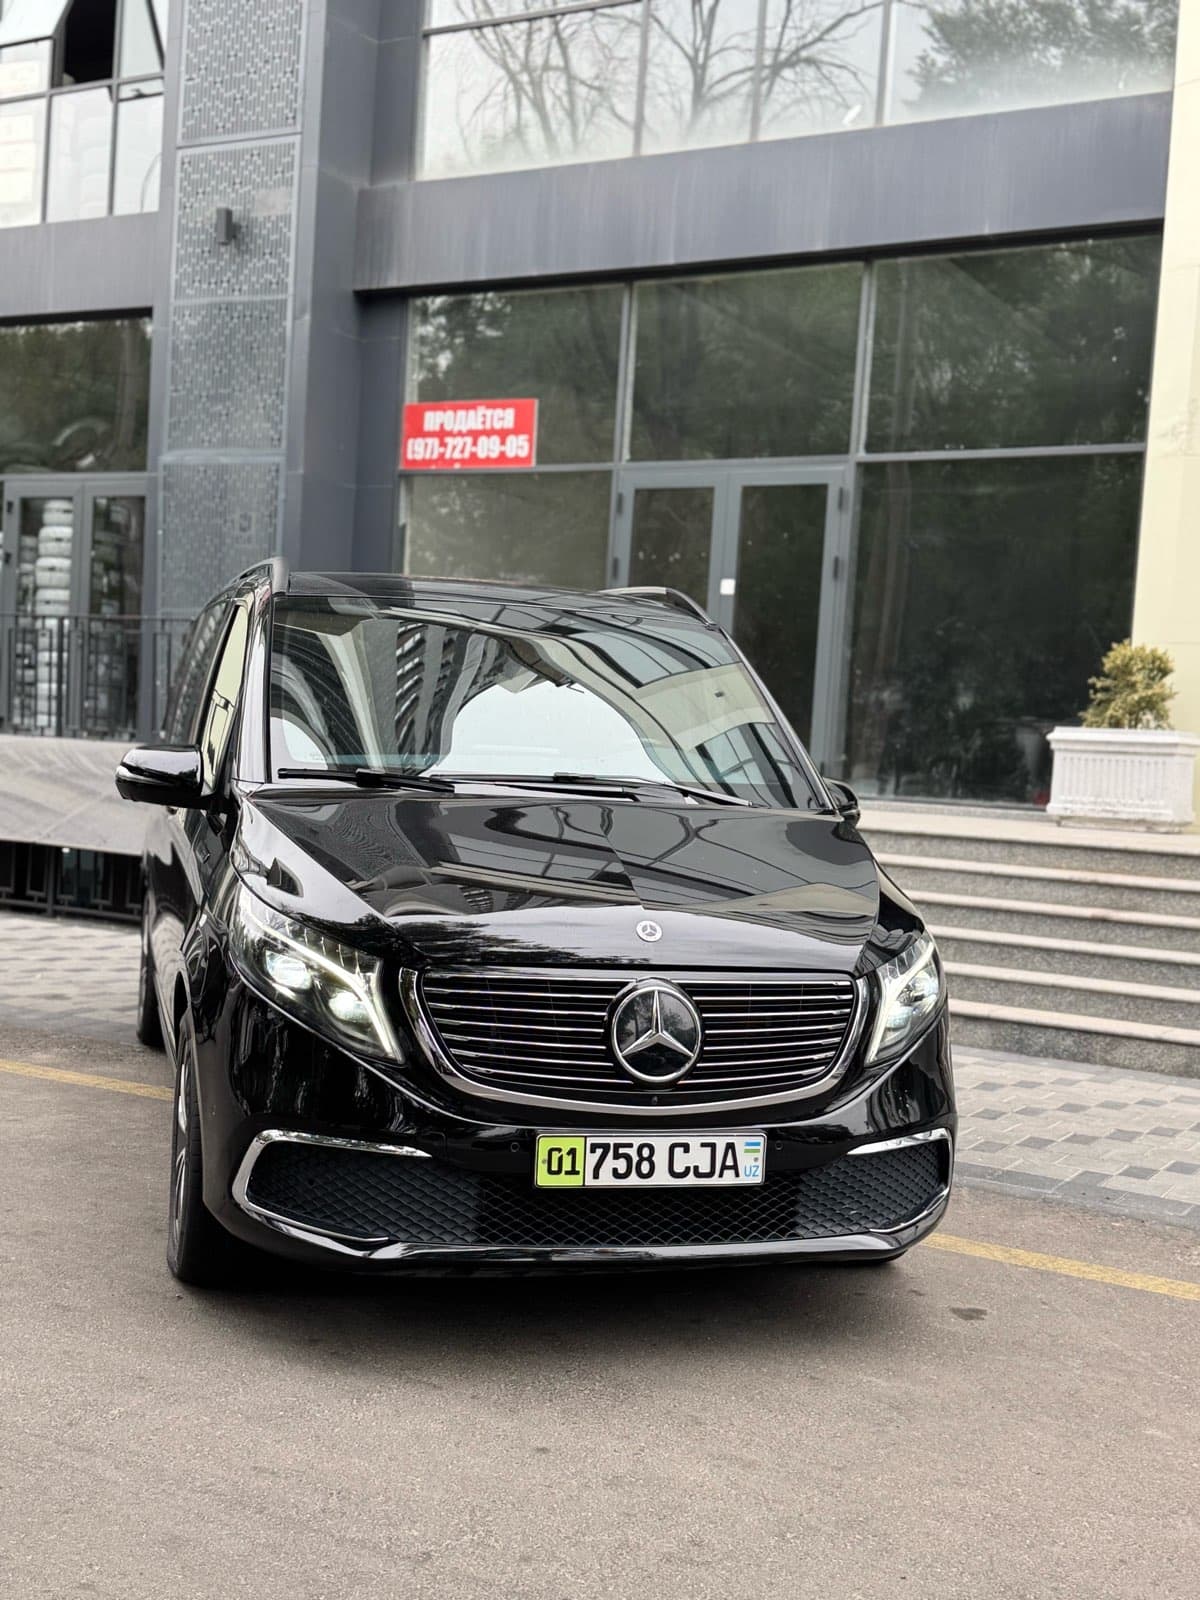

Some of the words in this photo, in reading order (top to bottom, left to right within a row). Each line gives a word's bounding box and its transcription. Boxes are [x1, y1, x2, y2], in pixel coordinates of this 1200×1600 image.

[423, 406, 515, 433] ПРОДАЁТСЯ
[406, 434, 530, 460] (97)-727-09-05
[547, 1147, 580, 1176] 01
[590, 1142, 656, 1180] 758
[668, 1142, 740, 1179] CJA
[744, 1165, 760, 1178] UZ
